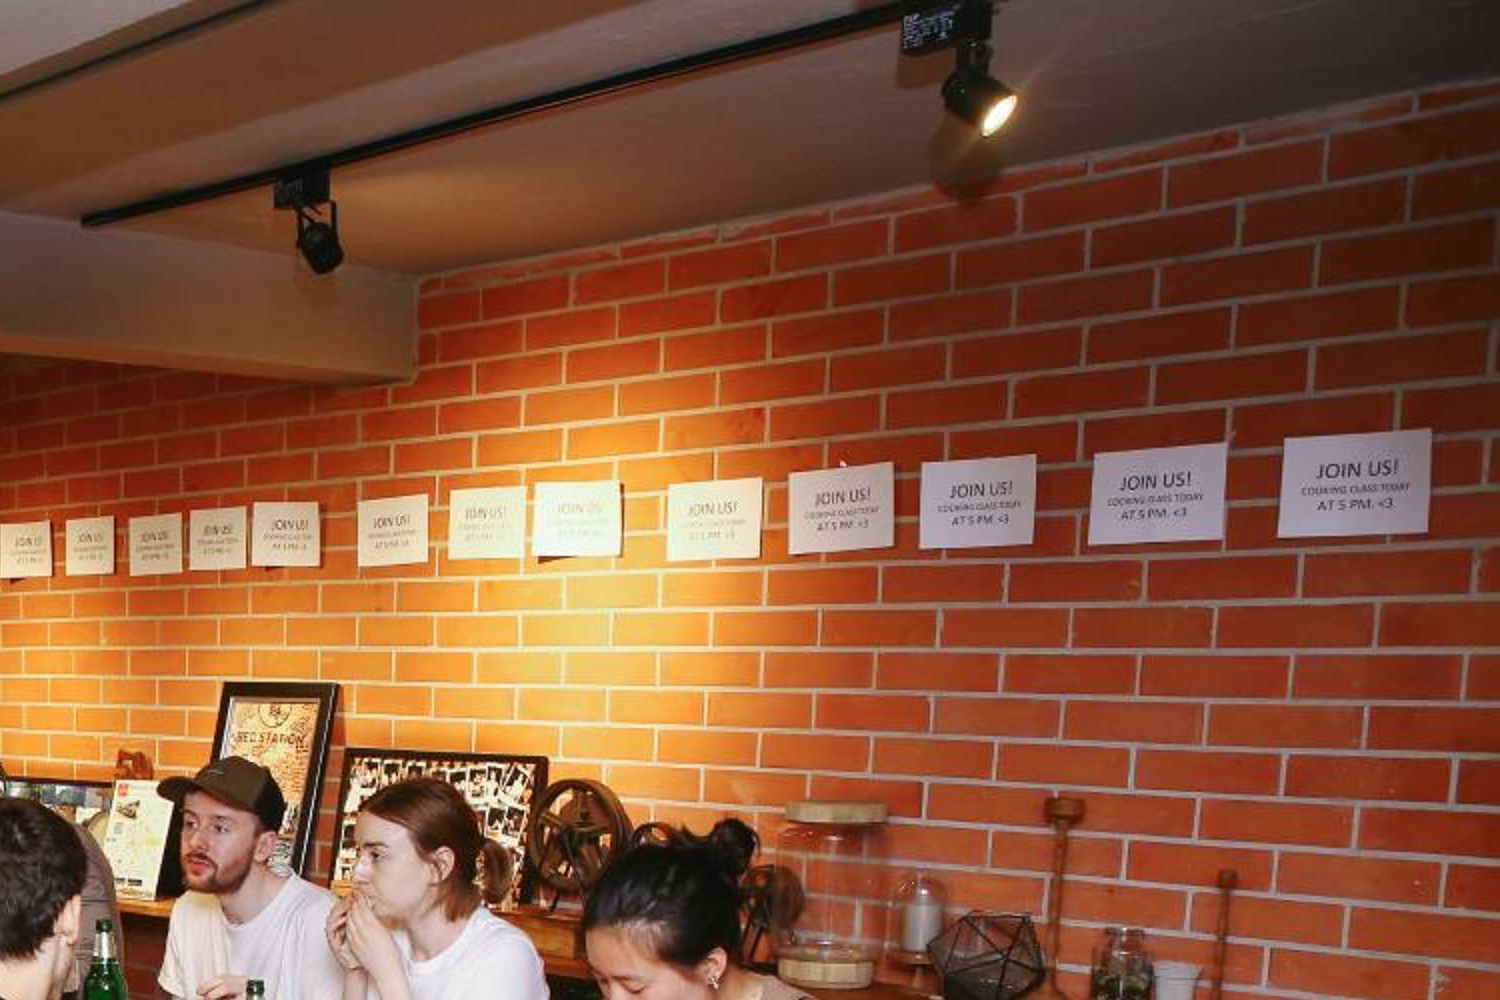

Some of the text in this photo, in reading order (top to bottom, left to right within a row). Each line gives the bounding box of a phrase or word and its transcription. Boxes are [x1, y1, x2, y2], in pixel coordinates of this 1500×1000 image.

[1315, 458, 1398, 479] JOIN US!
[950, 480, 1013, 499] JOIN US!
[1118, 471, 1191, 490] JOIN US!
[815, 487, 871, 507] JOIN US!
[1317, 499, 1334, 511] AT
[689, 500, 738, 517] JOIN US!
[1121, 509, 1135, 520] AT
[951, 515, 965, 526] AT
